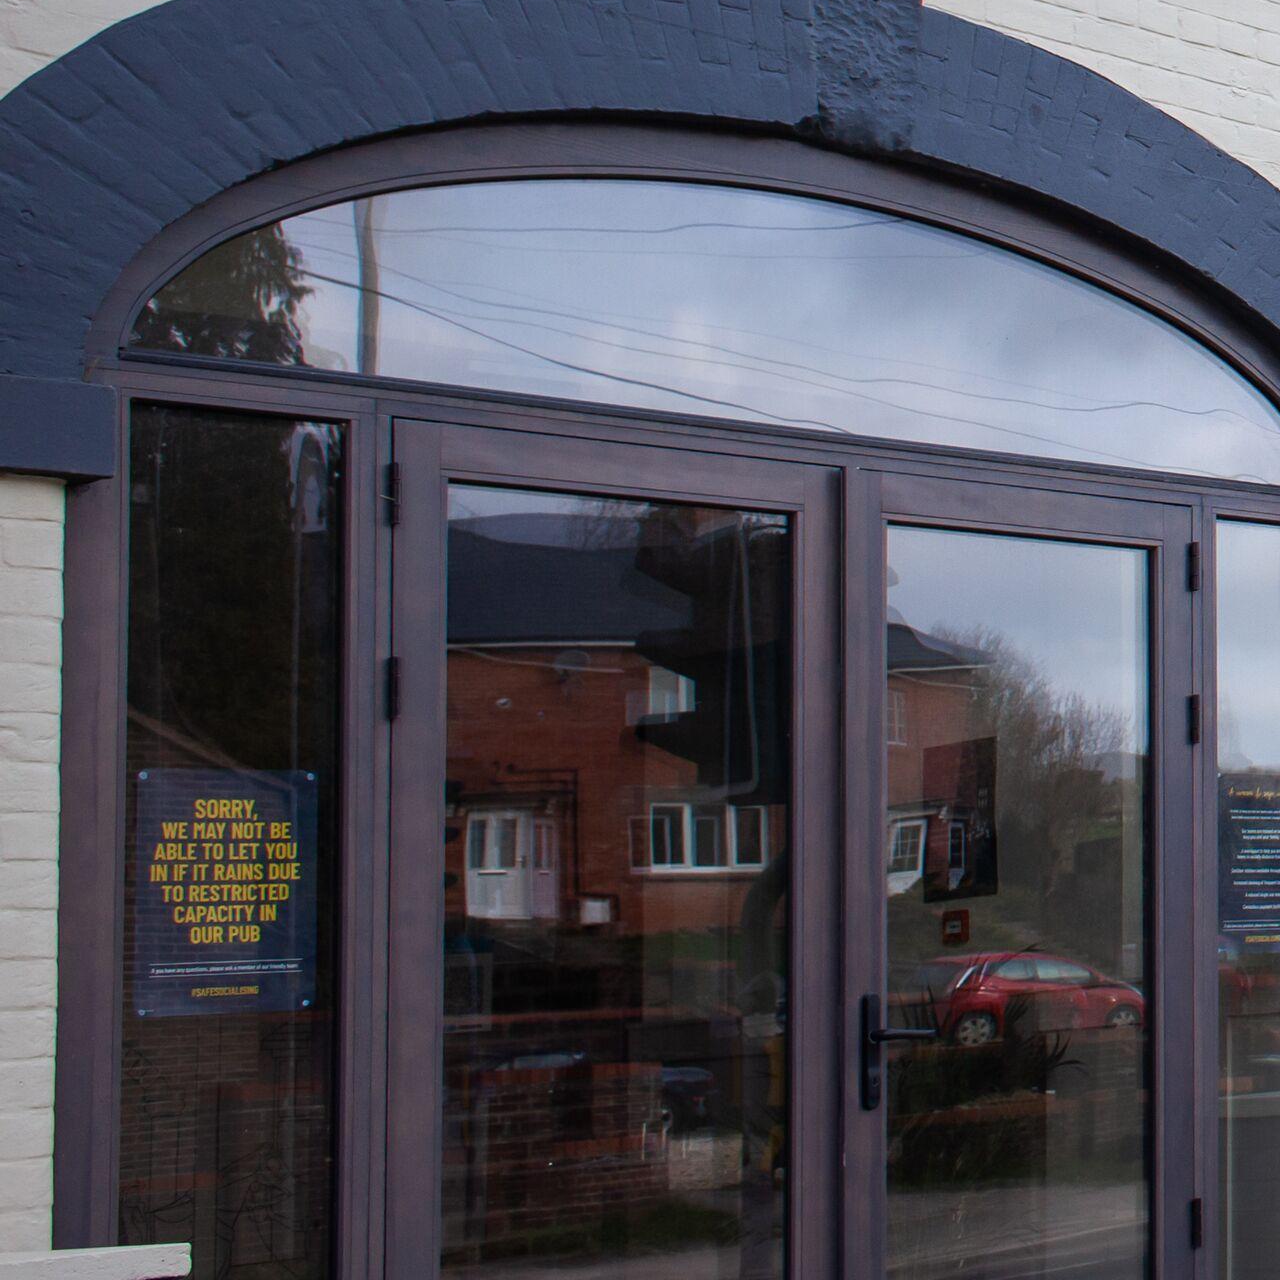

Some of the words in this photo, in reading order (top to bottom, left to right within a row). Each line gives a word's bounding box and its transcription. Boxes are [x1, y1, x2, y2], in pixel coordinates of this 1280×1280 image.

[194, 799, 258, 821] SORRY,
[161, 822, 188, 839] WE
[193, 822, 226, 839] MAY
[231, 822, 265, 839] NOT
[270, 822, 292, 839] BE
[154, 843, 197, 860] ABLE
[202, 843, 224, 860] TO
[229, 843, 260, 860] LET
[265, 842, 298, 860] YOU
[150, 865, 168, 882] IN
[173, 864, 188, 881] IF
[193, 864, 208, 881] IT
[213, 863, 264, 881] RAINS
[269, 863, 301, 880] DUE
[162, 885, 184, 902] TO
[188, 883, 290, 902] RESTRICTED
[173, 905, 255, 923] CAPACITY
[259, 904, 278, 921] IN
[190, 926, 224, 944] OUR
[228, 925, 261, 942] PUB
